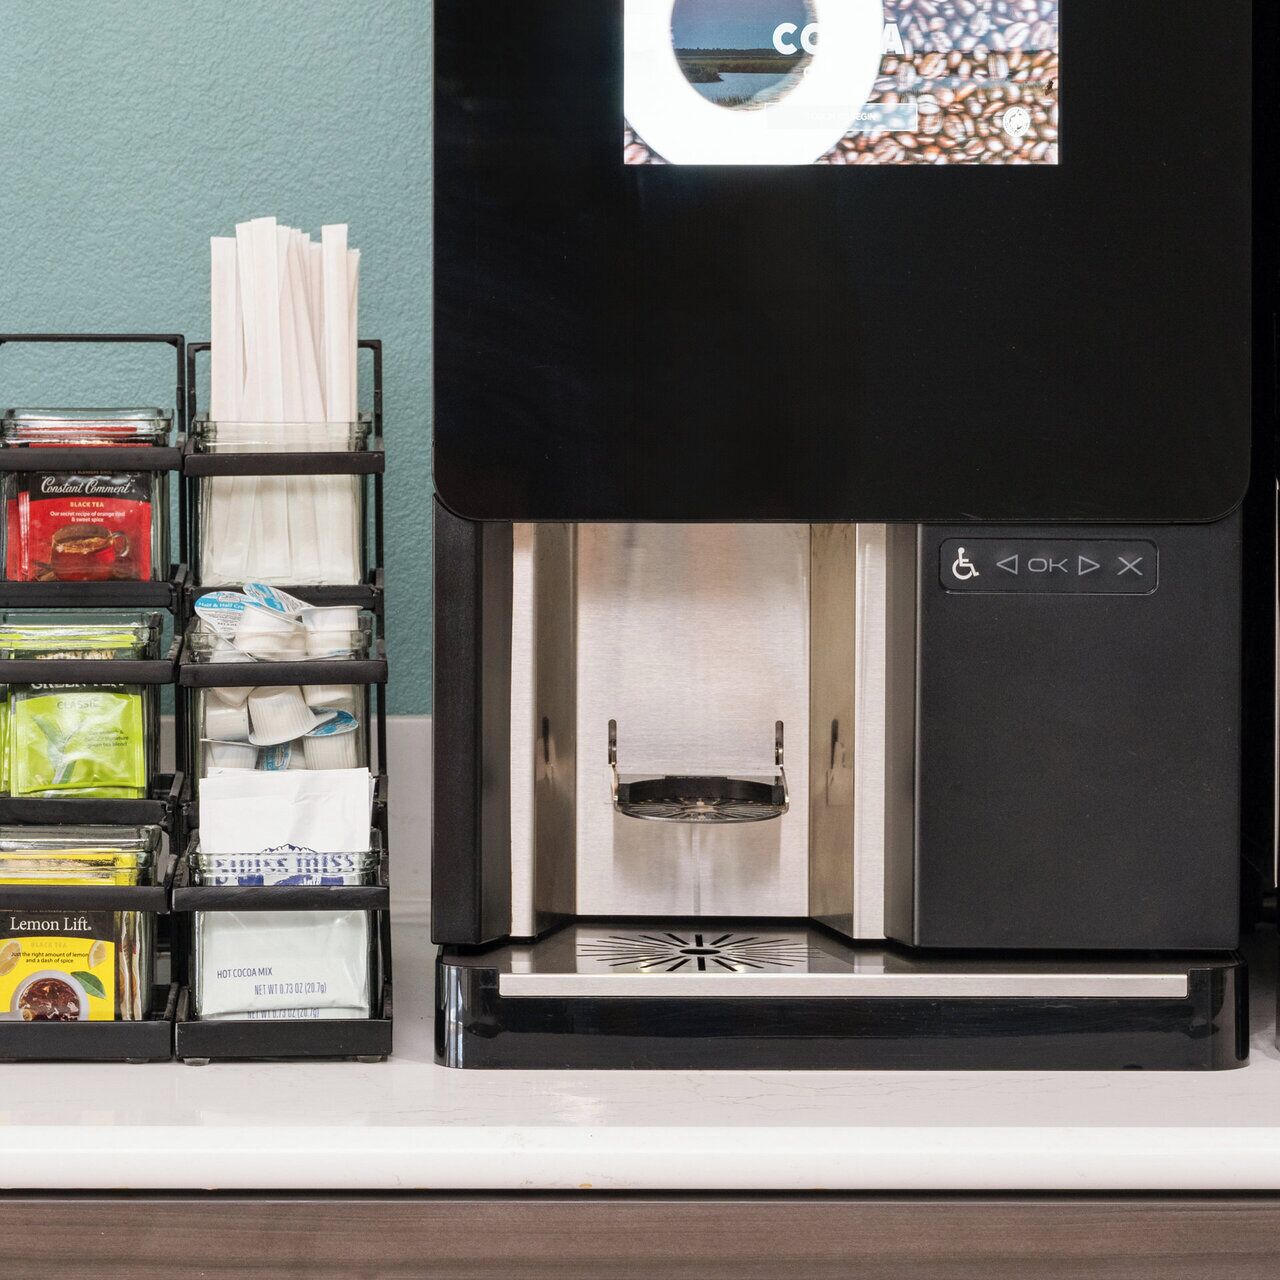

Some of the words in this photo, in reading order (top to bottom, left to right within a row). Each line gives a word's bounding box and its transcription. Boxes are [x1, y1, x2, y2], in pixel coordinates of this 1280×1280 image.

[773, 23, 905, 55] COA
[851, 112, 876, 121] EGIN
[1027, 558, 1068, 573] OK
[10, 916, 60, 931] Lemon
[217, 969, 231, 979] HOT
[232, 968, 257, 978] COCOA
[258, 967, 272, 977] MIX
[254, 984, 266, 995] NET
[267, 984, 278, 994] WT
[279, 983, 293, 994] 0.73
[294, 983, 304, 994] OZ
[304, 982, 327, 995] (20.7g)
